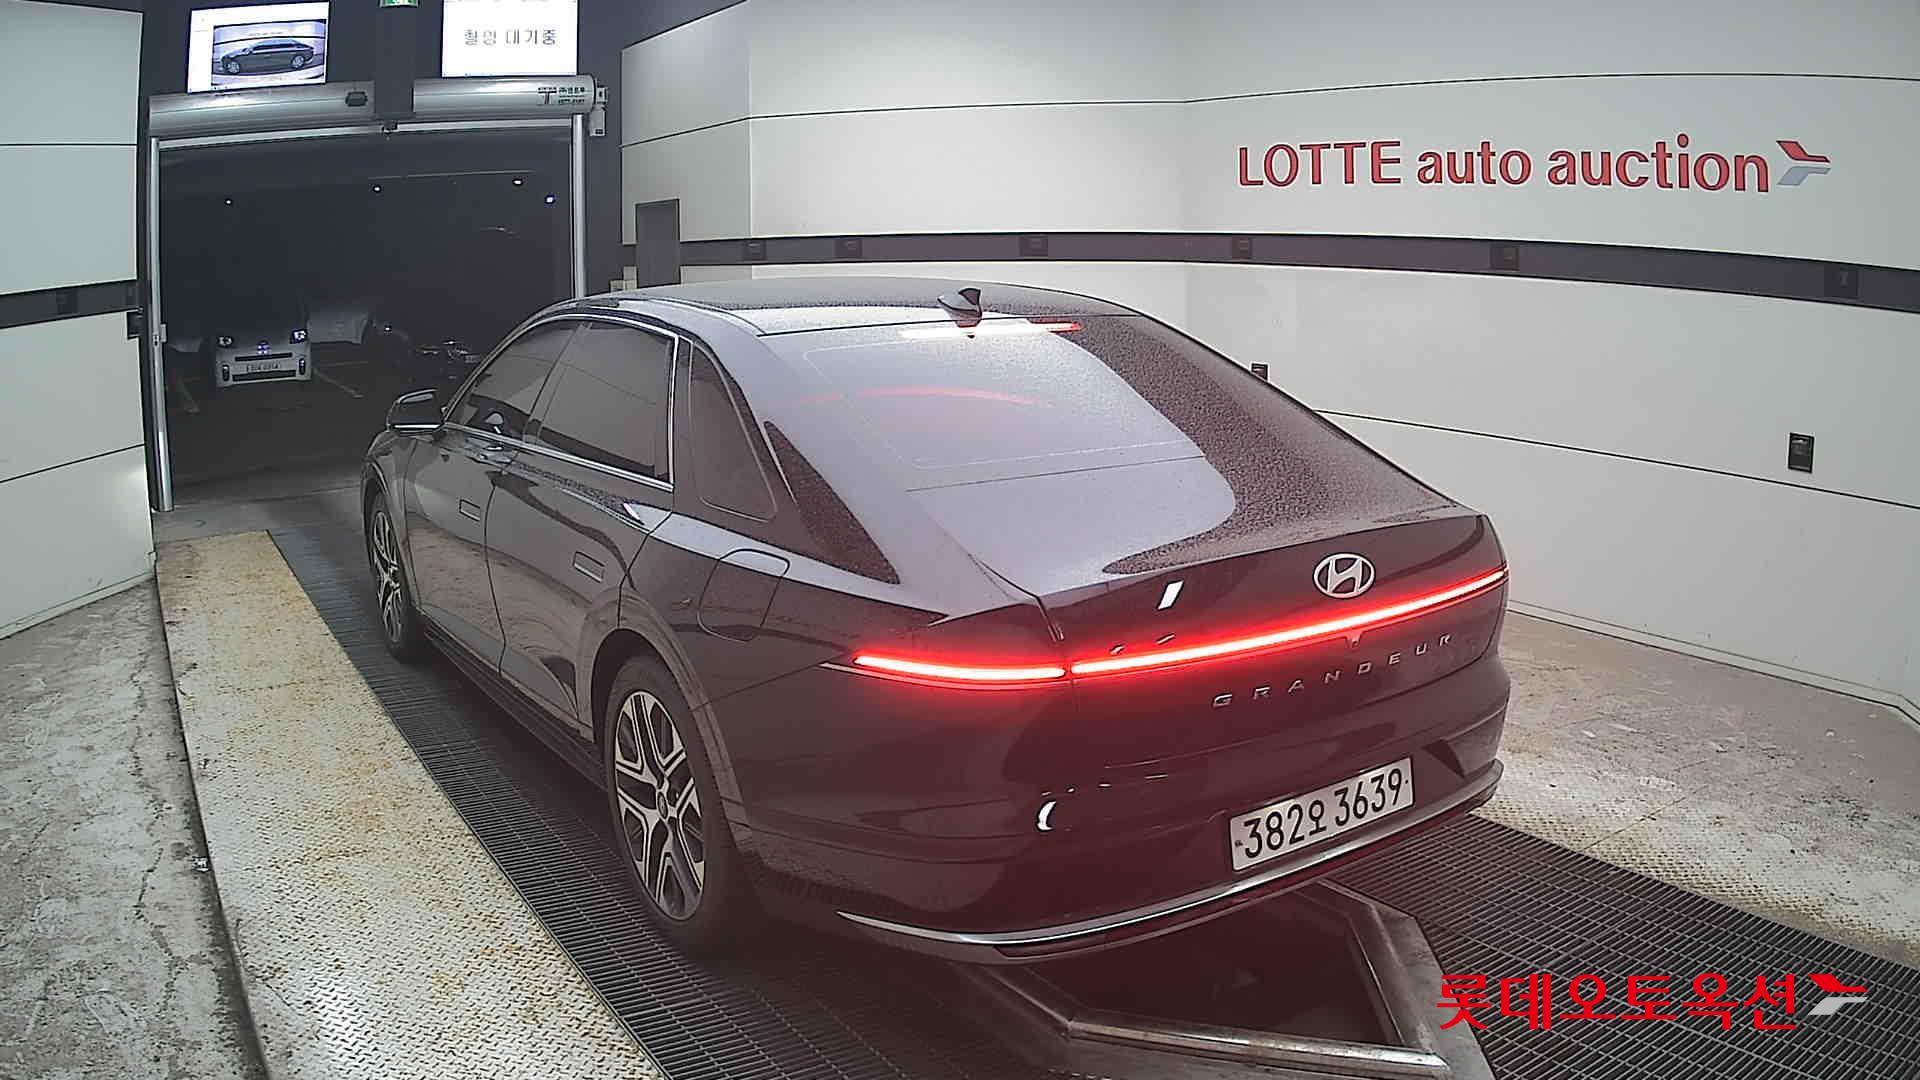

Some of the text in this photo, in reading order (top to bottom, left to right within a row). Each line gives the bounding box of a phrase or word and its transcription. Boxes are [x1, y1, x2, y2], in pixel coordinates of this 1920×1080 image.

[505, 28, 558, 46] 대기중
[1238, 134, 1770, 193] LOTTE auto auction
[1212, 633, 1452, 707] GRANDEUR
[1333, 768, 1402, 827] 3639
